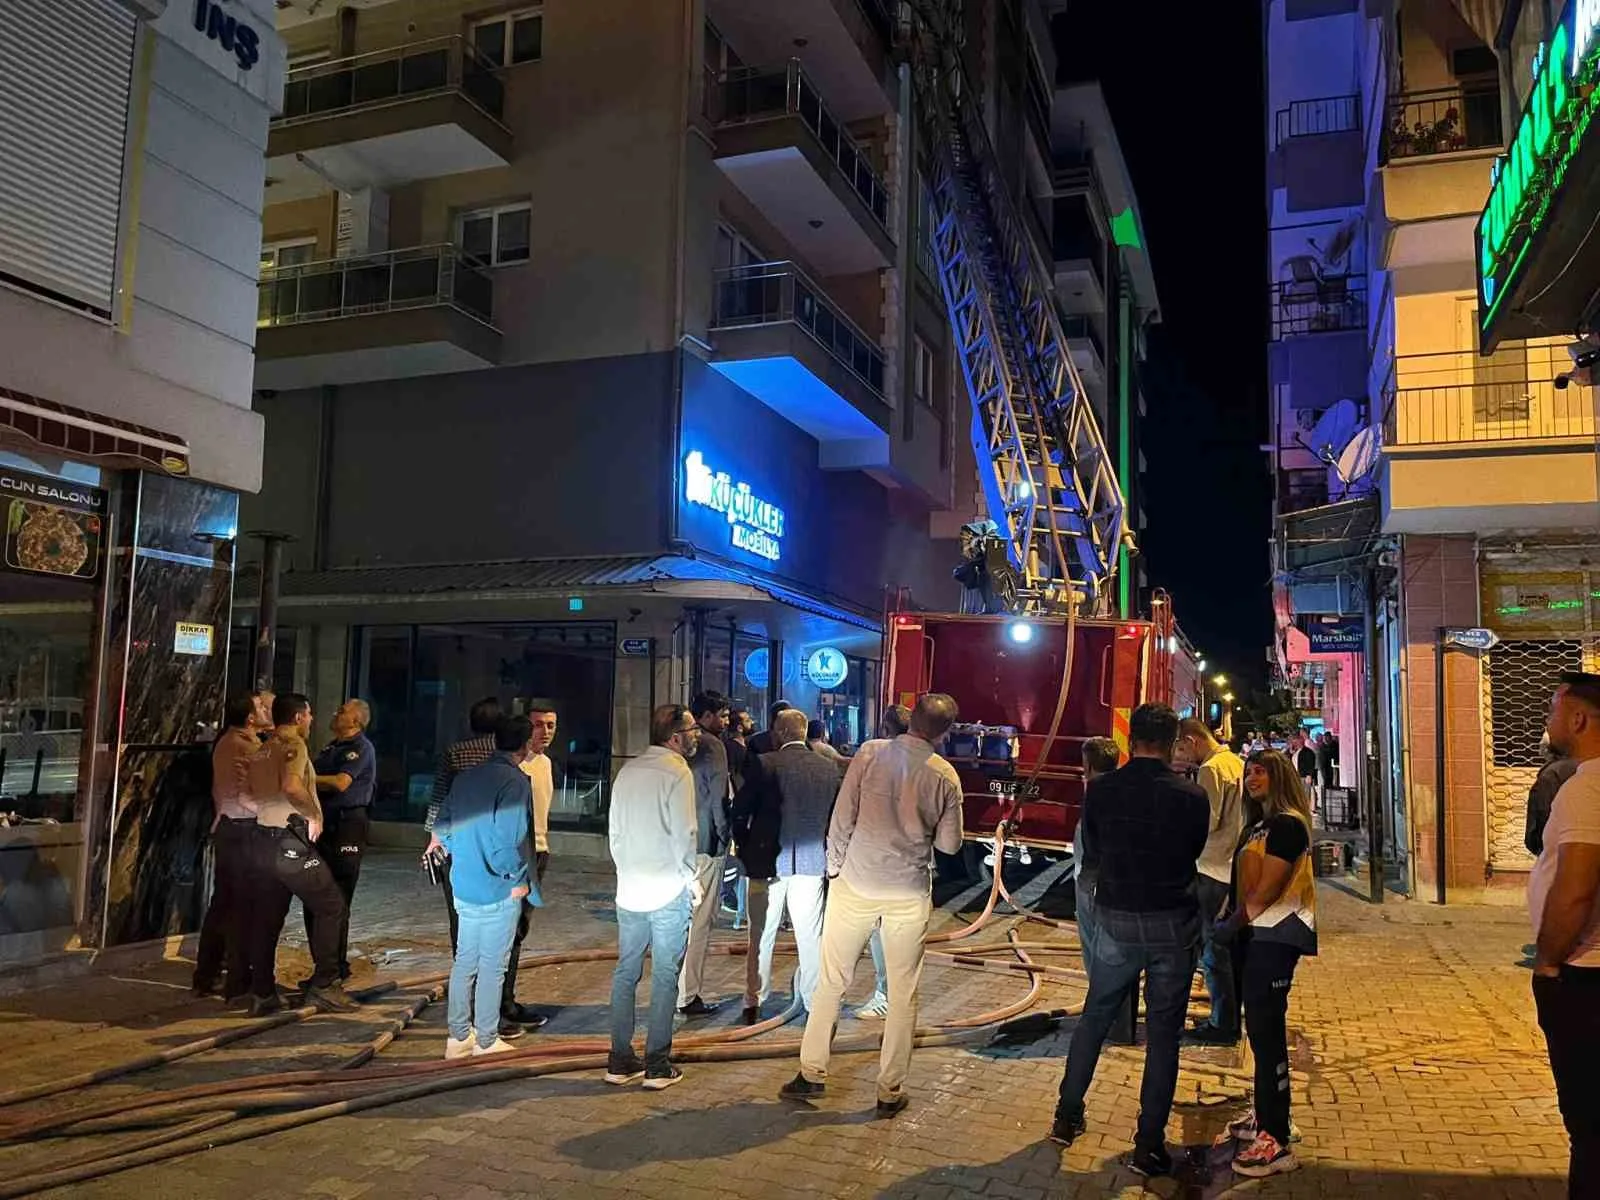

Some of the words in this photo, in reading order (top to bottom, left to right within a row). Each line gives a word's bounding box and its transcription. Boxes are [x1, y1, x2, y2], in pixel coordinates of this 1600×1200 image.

[37, 485, 101, 506] SALONU
[710, 471, 785, 538] KÜÇÜKLER
[989, 782, 1002, 792] 09
